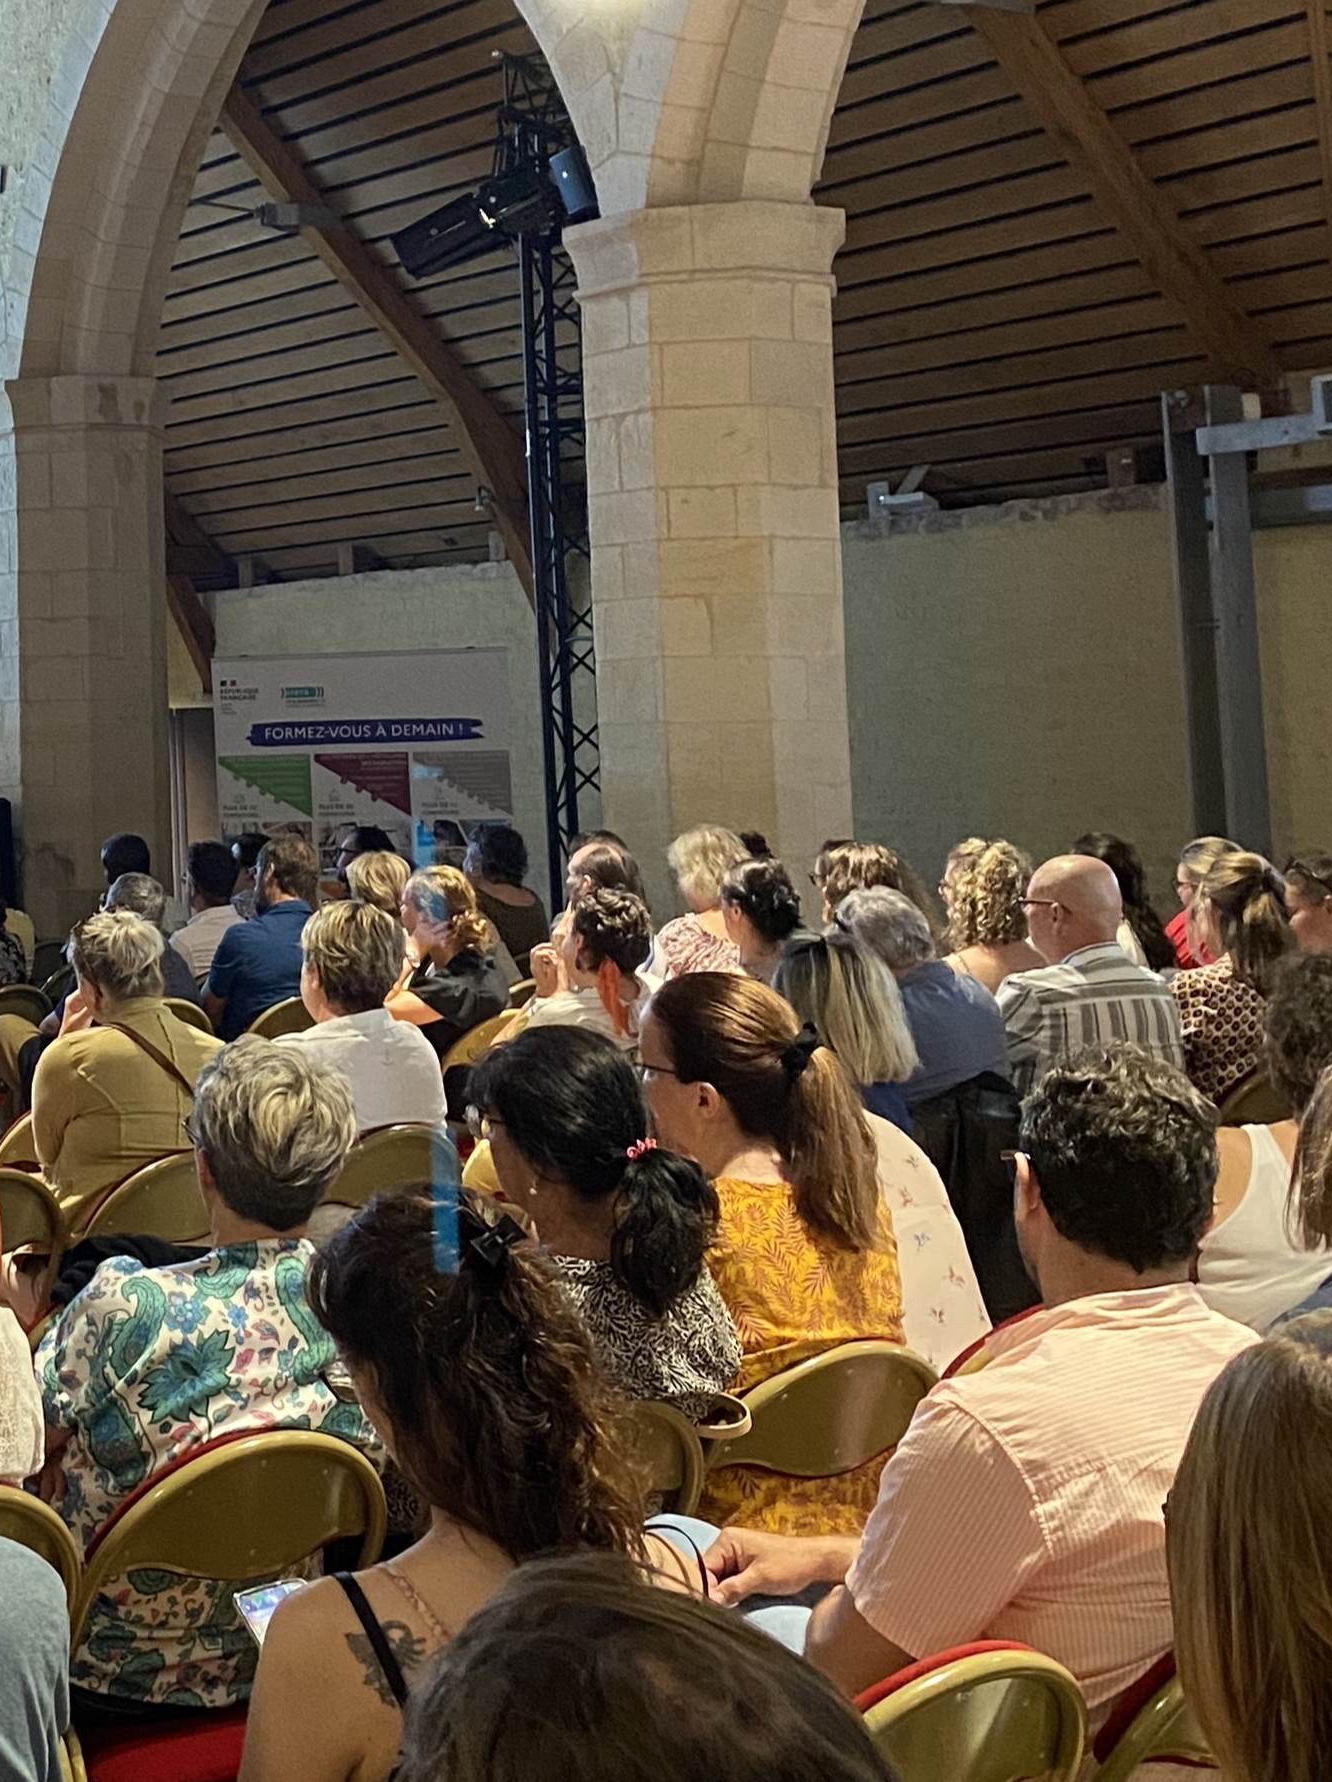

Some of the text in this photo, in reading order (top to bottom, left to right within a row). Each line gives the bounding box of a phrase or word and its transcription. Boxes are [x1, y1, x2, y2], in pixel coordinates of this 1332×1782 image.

[265, 725, 371, 740] FORMEZ-VOUS
[376, 722, 387, 737] À
[391, 723, 454, 737] DEMAIN
